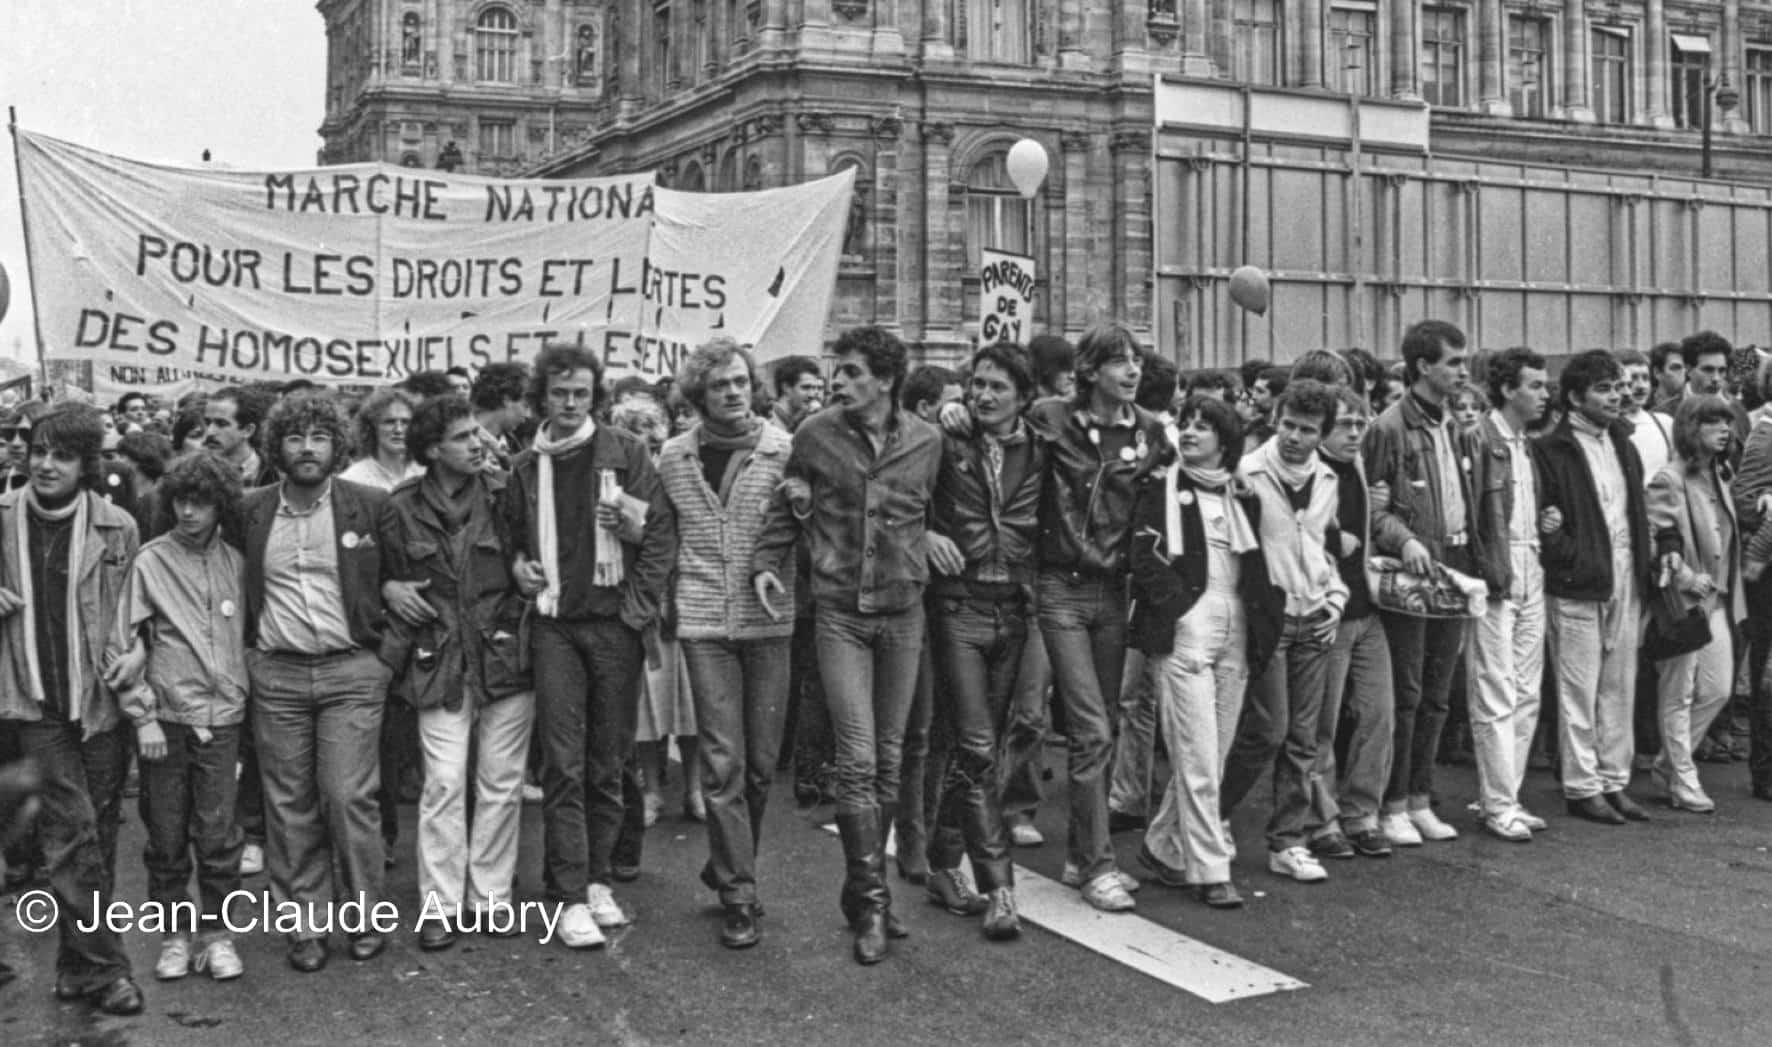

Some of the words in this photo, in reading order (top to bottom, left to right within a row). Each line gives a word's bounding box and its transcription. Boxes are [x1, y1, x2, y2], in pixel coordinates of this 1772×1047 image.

[265, 173, 448, 221] MARCHE
[485, 182, 656, 222] NATIONA
[136, 233, 262, 290] POUR
[283, 251, 375, 296] LES
[392, 257, 523, 299] DROITS
[539, 259, 594, 297] ET
[611, 257, 727, 310] LIRTES
[983, 260, 1035, 304] PARENTS
[983, 312, 1022, 344] GAY
[997, 295, 1018, 317] DE
[74, 308, 179, 355] DES
[195, 324, 492, 379] HOMOSEXUELS
[110, 365, 146, 385] NON
